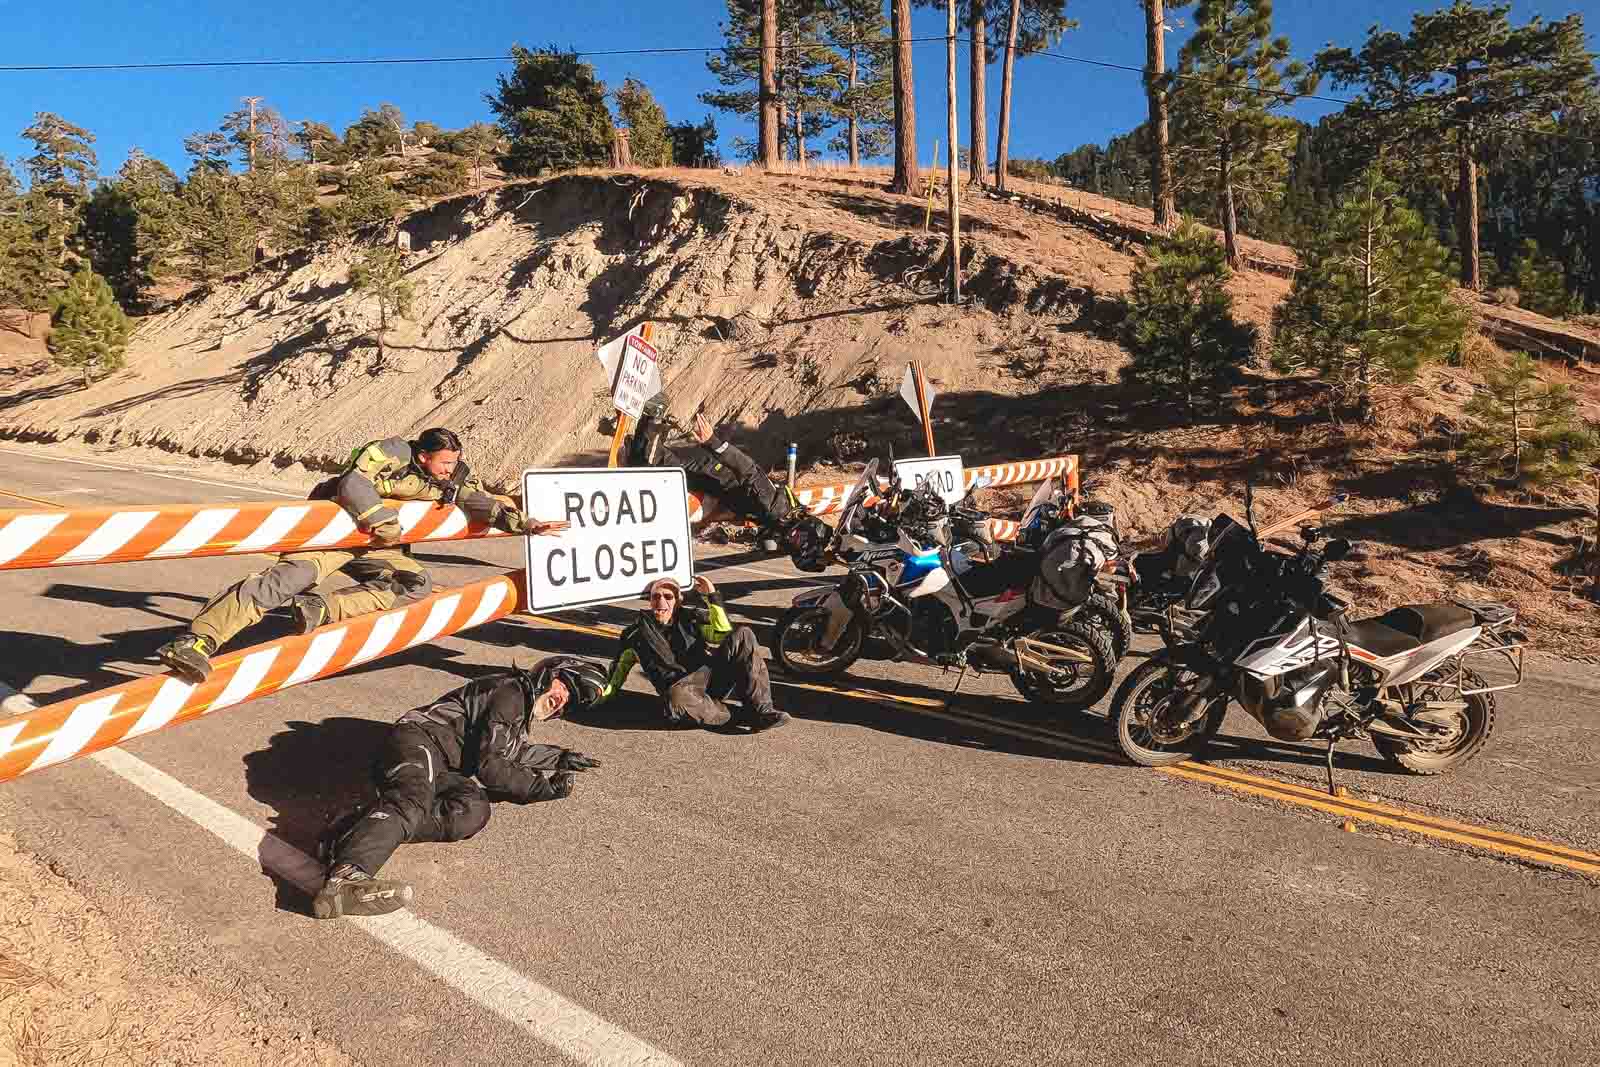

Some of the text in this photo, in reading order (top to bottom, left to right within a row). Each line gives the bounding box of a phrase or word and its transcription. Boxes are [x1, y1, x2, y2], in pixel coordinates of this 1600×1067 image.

[633, 354, 647, 375] NO
[623, 370, 647, 395] PARKING
[564, 489, 658, 527] ROAD
[546, 538, 678, 586] CLOSED
